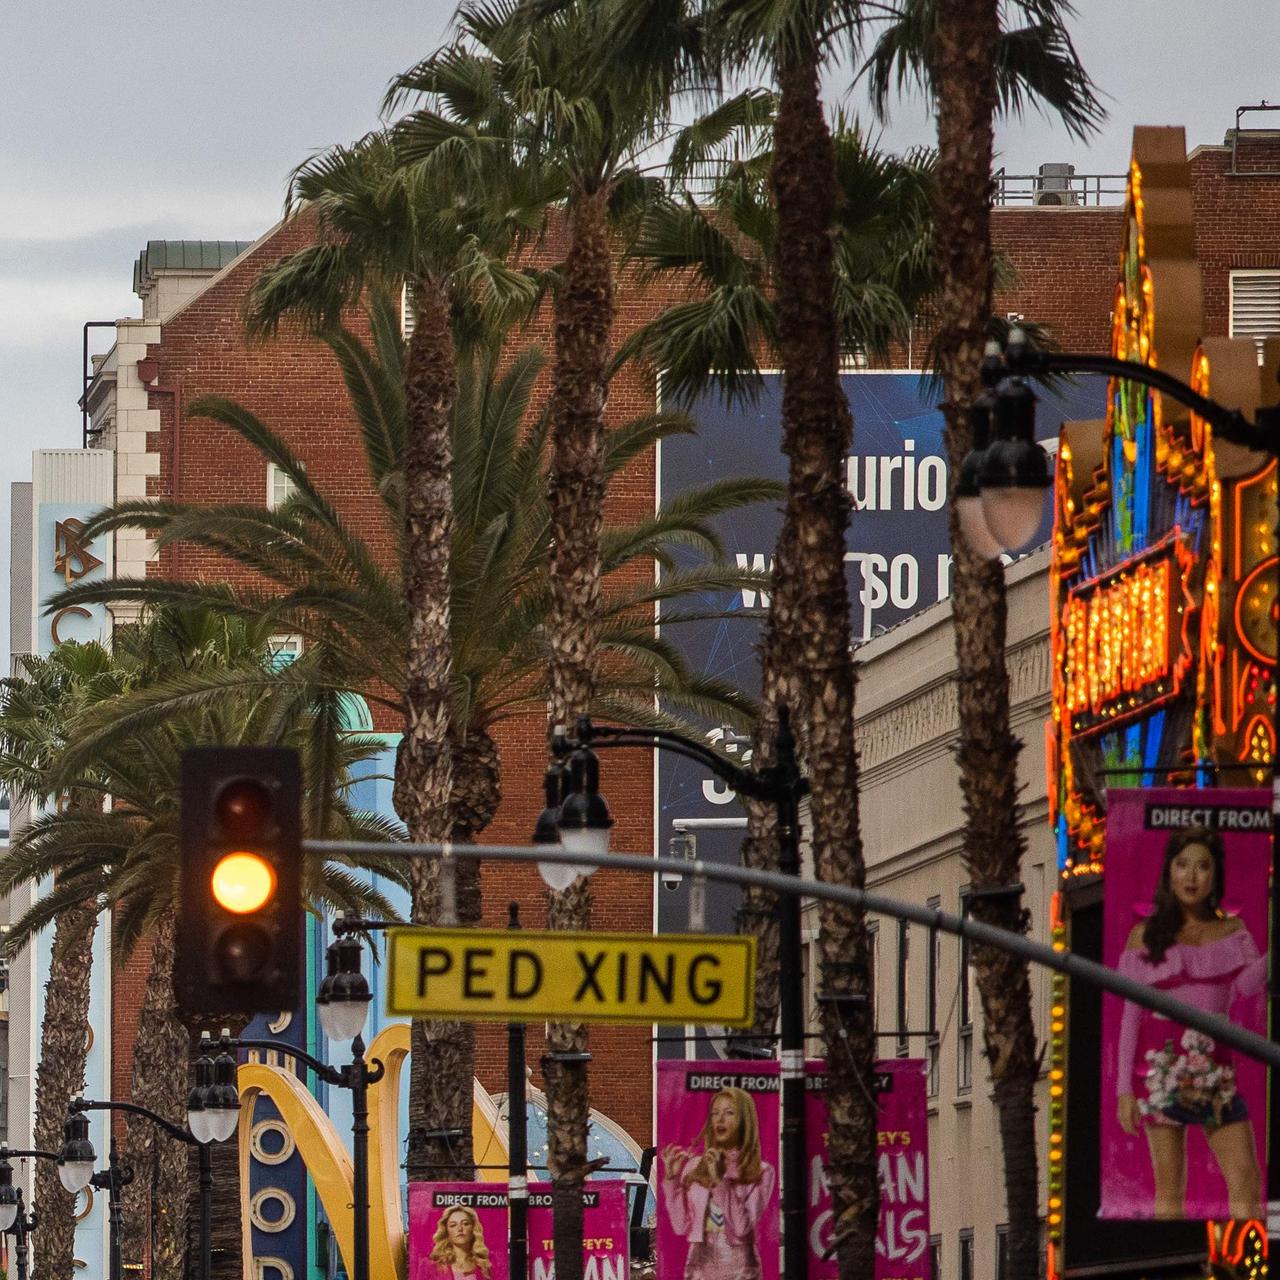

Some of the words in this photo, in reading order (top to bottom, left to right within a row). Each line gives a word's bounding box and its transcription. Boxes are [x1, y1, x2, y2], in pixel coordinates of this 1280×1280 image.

[1151, 808, 1213, 828] DIRECT
[1218, 809, 1271, 828] FROM
[417, 947, 543, 1000] PED
[574, 951, 723, 1004] XING
[691, 1076, 737, 1090] DIRECT
[741, 1077, 780, 1090] FROM
[811, 1151, 924, 1206] MAN
[436, 1194, 472, 1206] DIRECT
[476, 1194, 508, 1206] FROM
[529, 1194, 595, 1206] BROAY
[810, 1210, 928, 1264] GLS
